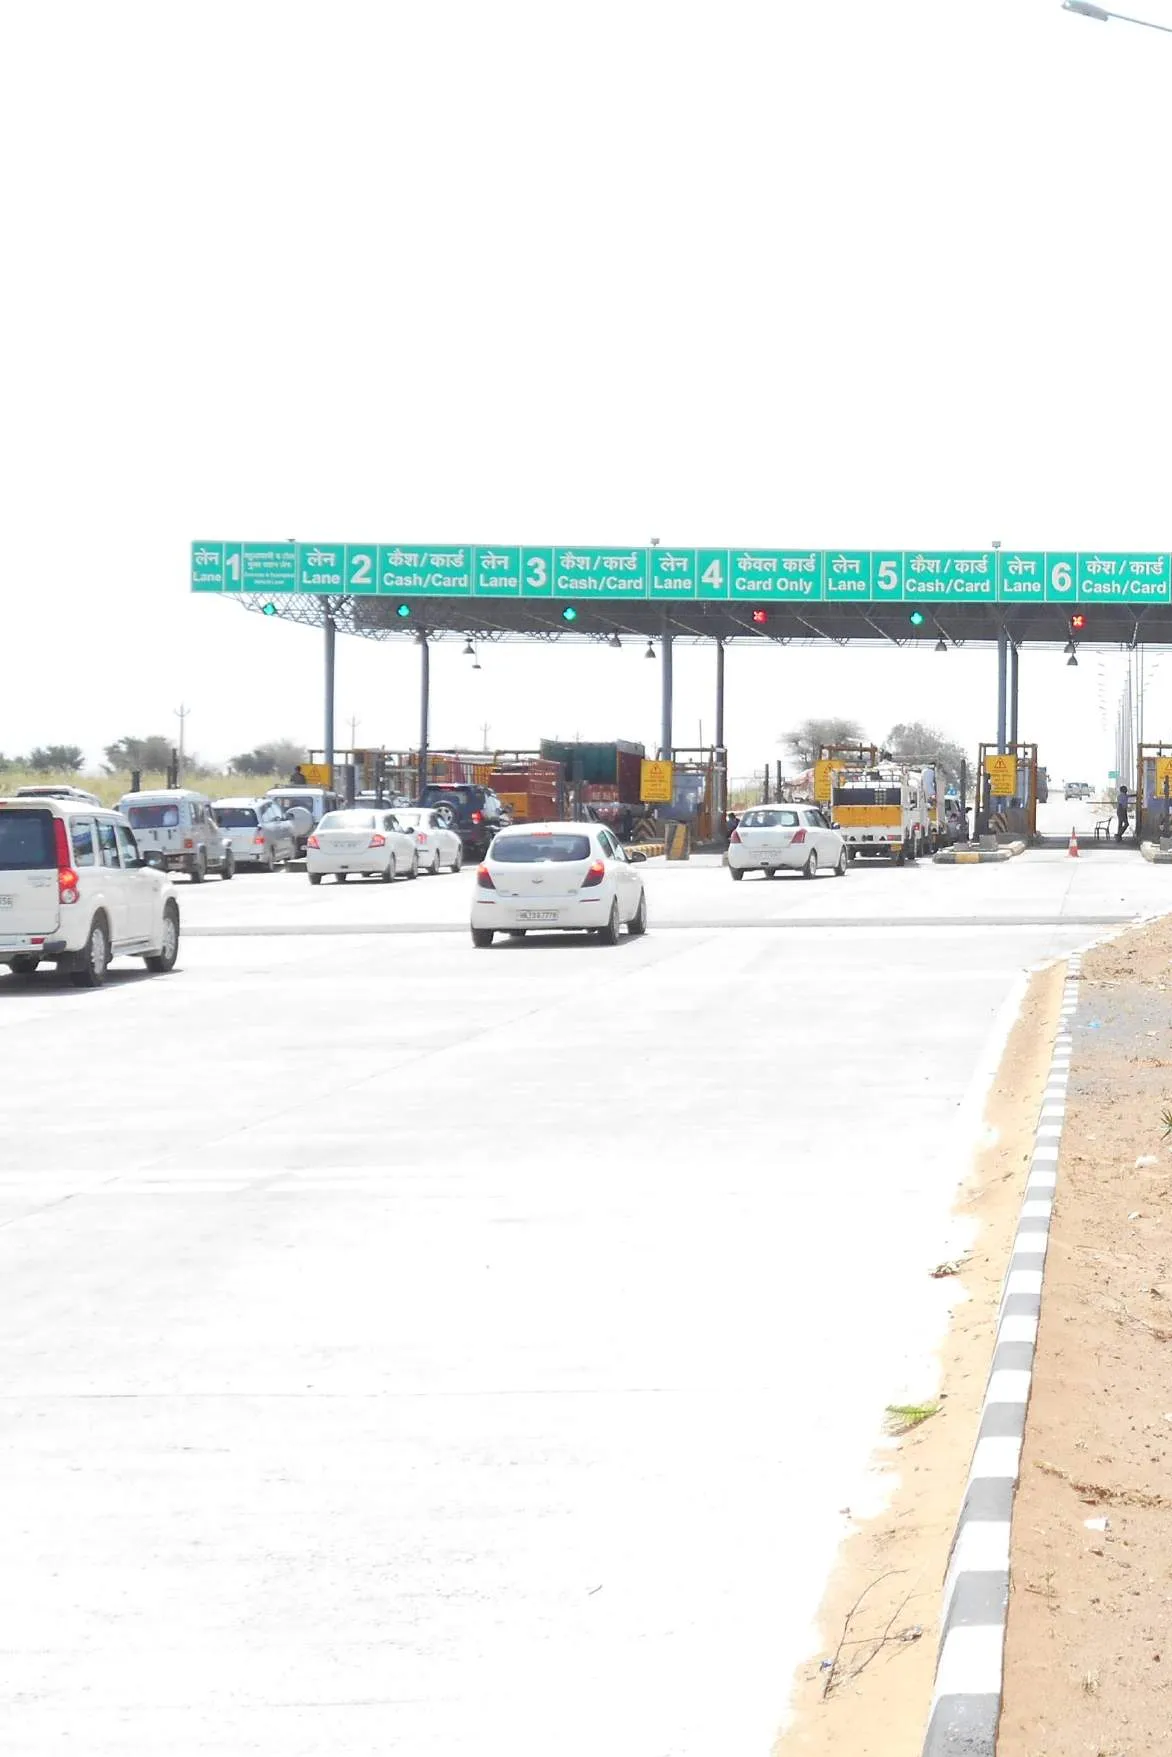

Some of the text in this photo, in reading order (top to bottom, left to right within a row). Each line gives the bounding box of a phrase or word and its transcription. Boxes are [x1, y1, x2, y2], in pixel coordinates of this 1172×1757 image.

[194, 548, 219, 565] लेन
[306, 548, 336, 567] लेन
[480, 551, 509, 570] लेन
[658, 552, 688, 572] लेन
[737, 553, 816, 572] केवल कार्ड
[832, 555, 860, 574] लेन
[1007, 556, 1037, 575] लेन
[226, 553, 240, 581] 1
[351, 554, 372, 584] 2
[527, 557, 547, 587] 3
[702, 559, 723, 589] 4
[877, 561, 898, 590] 5
[193, 571, 222, 582] Lane
[302, 571, 340, 584] Lane
[383, 572, 469, 588] Cash/Card
[480, 574, 517, 588] Lane
[557, 575, 643, 591] Cash/Card
[654, 576, 692, 589] Lane
[828, 578, 866, 591] Lane
[1003, 579, 1041, 592] Lane
[1051, 562, 1072, 592] 6
[735, 578, 813, 594] Card Only
[906, 579, 990, 594] Cash/Card
[1082, 580, 1167, 595] Cash/Card
